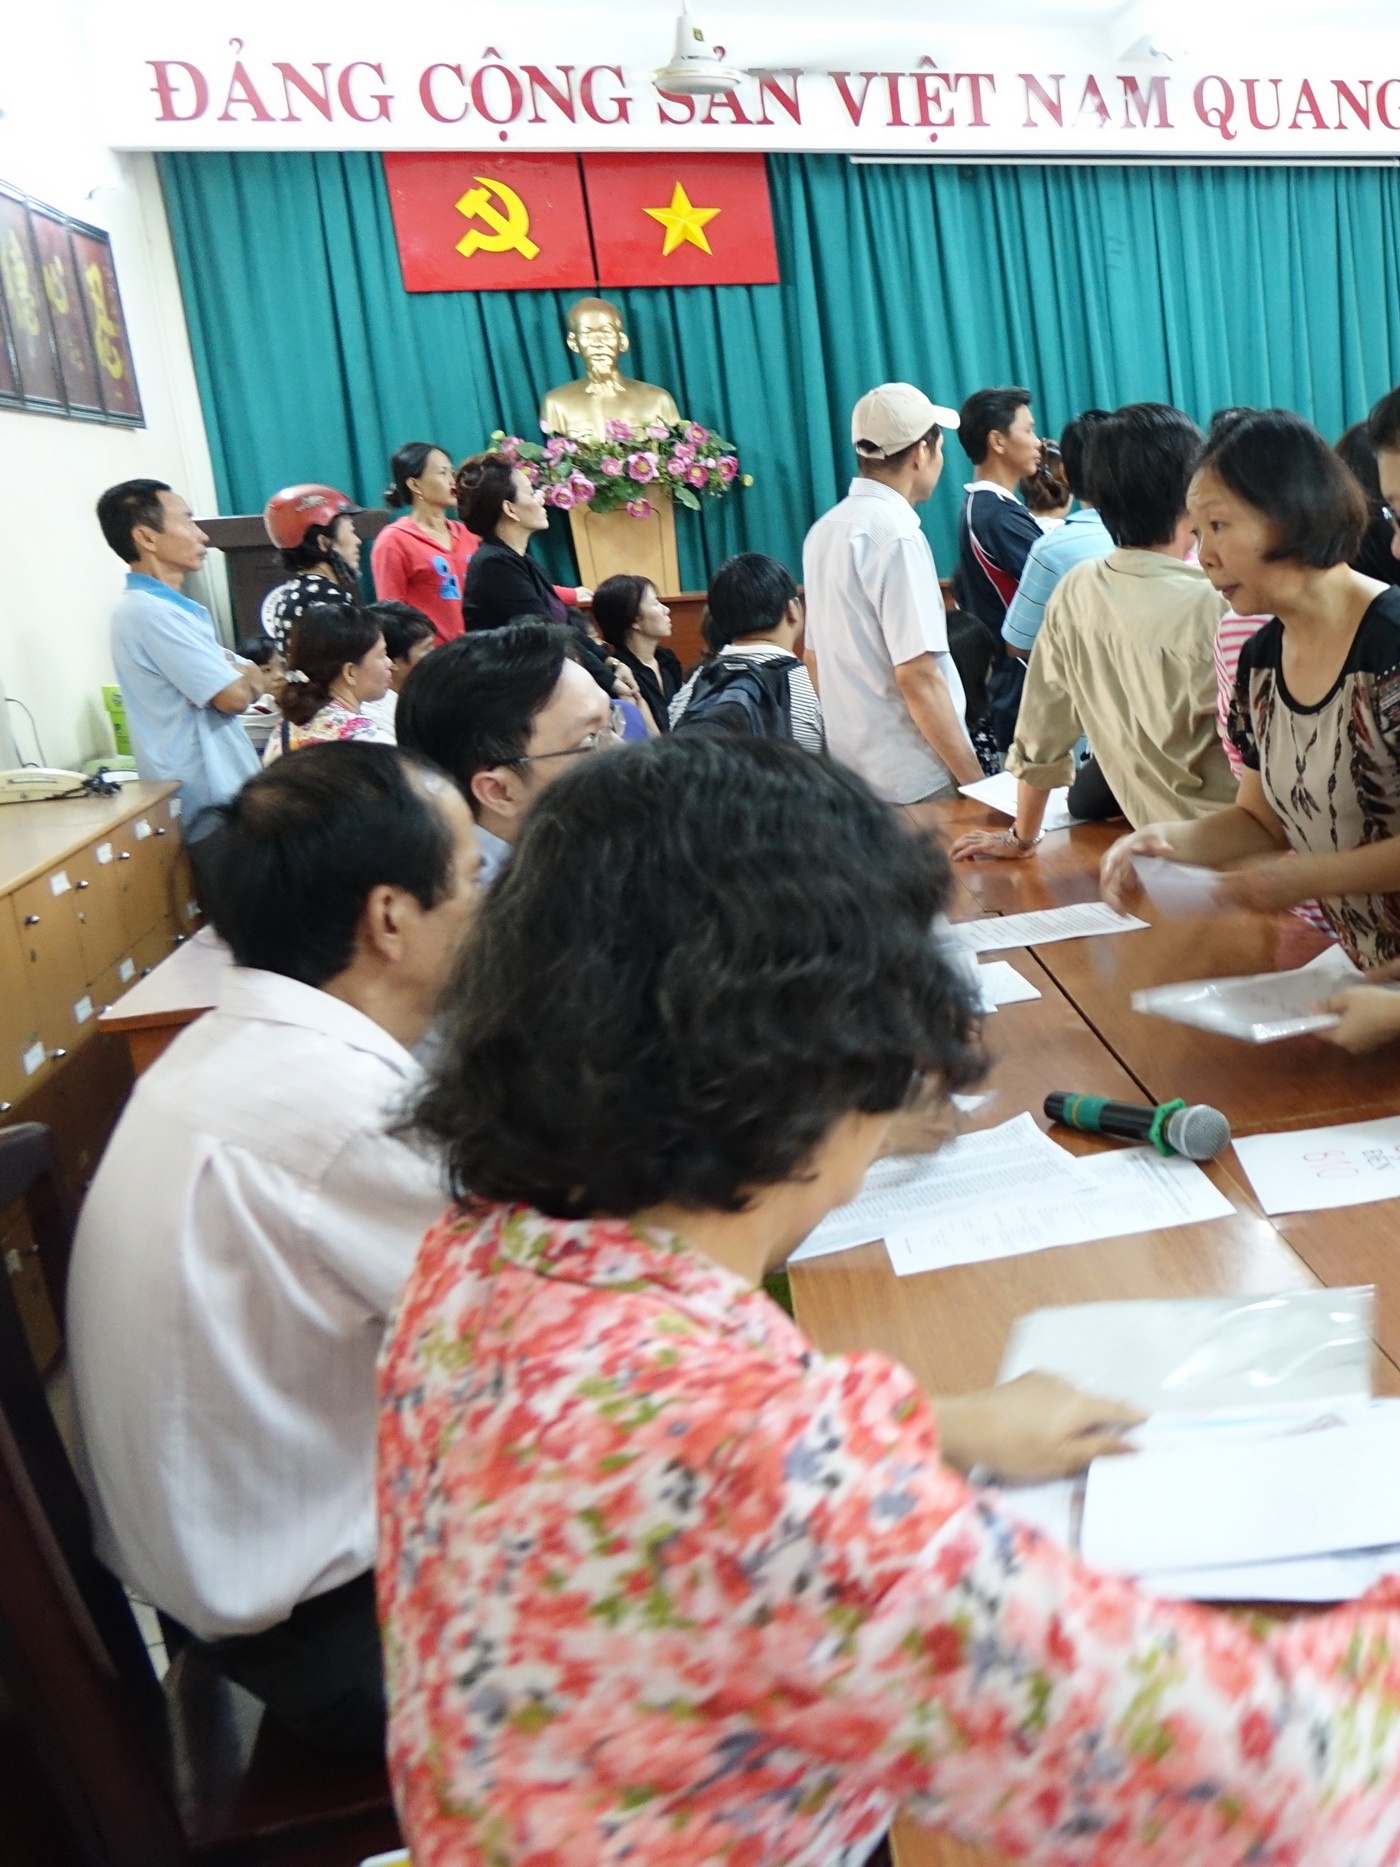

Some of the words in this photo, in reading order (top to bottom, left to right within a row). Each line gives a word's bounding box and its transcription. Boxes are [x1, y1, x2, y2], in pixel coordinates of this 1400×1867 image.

[145, 38, 394, 123] ĐẢNG
[418, 47, 633, 142] CỘNG
[826, 56, 998, 143] VIỆT
[1017, 73, 1175, 130] NAM
